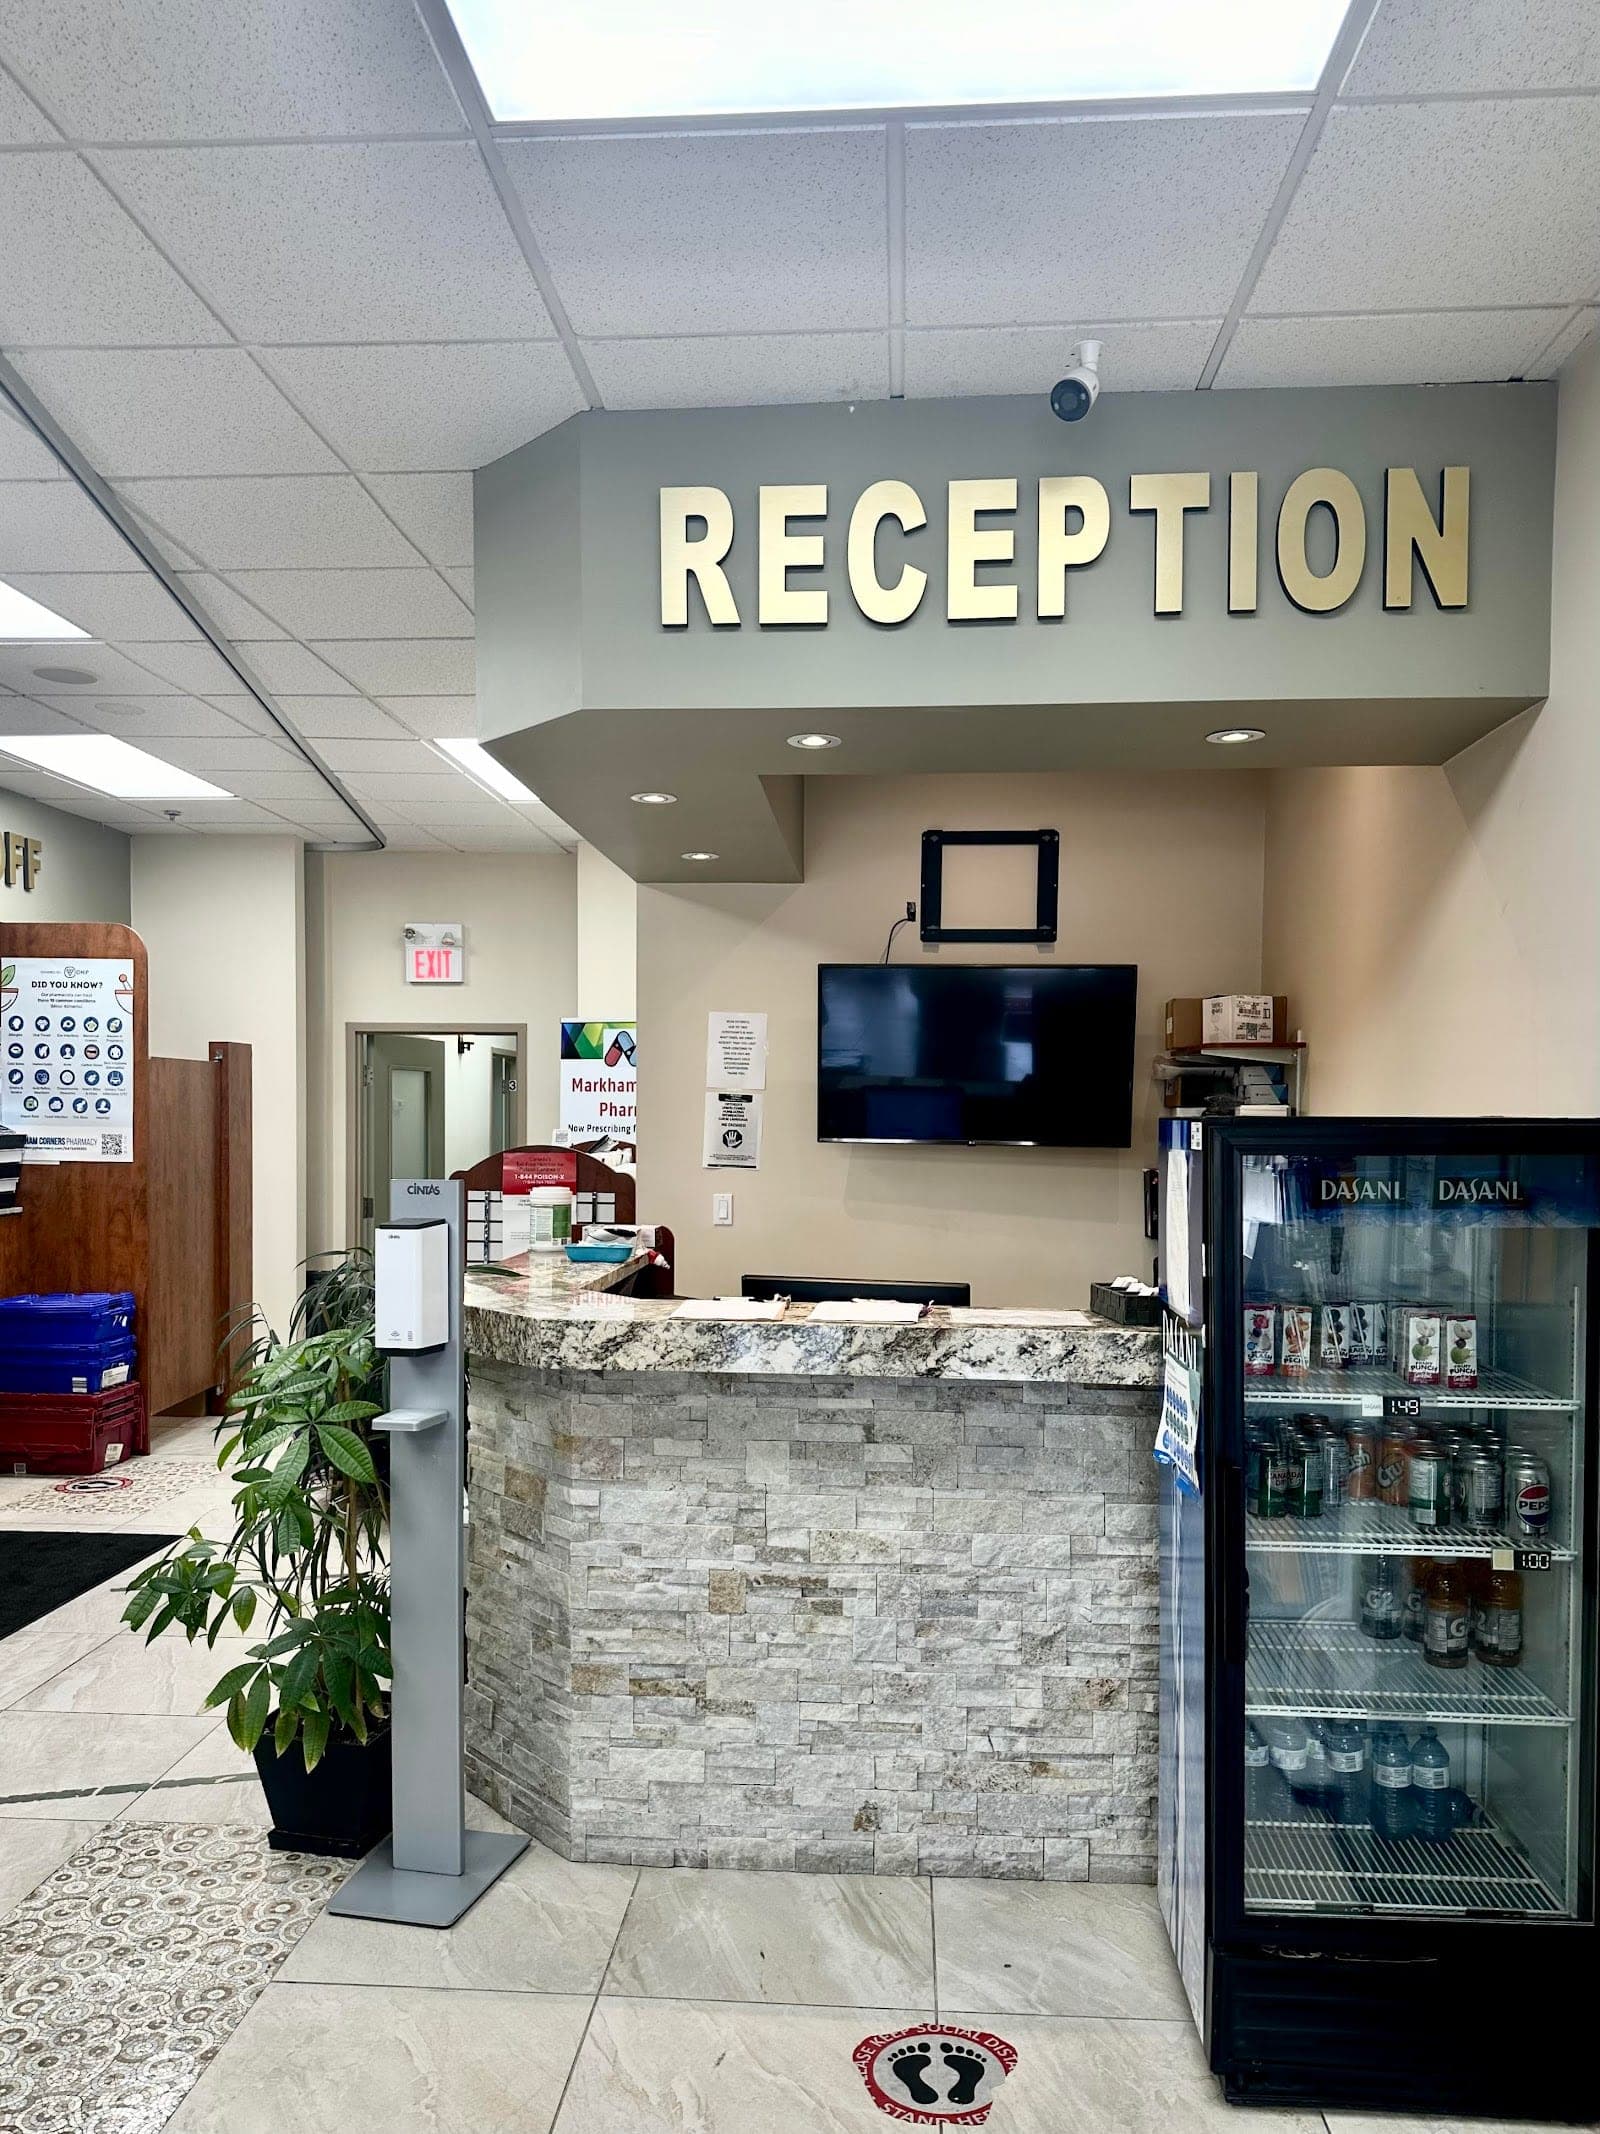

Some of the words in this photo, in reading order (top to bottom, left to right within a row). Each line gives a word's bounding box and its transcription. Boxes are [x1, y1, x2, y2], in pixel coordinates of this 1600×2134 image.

[659, 466, 1470, 628] RECEPTION
[0, 831, 42, 892] FF
[414, 950, 452, 978] EXIT
[70, 981, 103, 989] KNOW?
[509, 1080, 516, 1090] 3
[599, 1101, 637, 1117] Phar
[568, 1124, 585, 1133] Now
[586, 1124, 631, 1135] Prescribing
[39, 1137, 66, 1146] CORNERS
[66, 1138, 97, 1146] PHARMACY
[1321, 1177, 1400, 1203] DASANI
[1439, 1177, 1519, 1203] DASANI
[1410, 1363, 1438, 1372] PUNCH
[1391, 1399, 1419, 1415] 1.49
[1522, 1553, 1550, 1569] 1.00
[1366, 1590, 1394, 1609] G2
[1450, 1617, 1466, 1637] G
[916, 2023, 981, 2041] SOCIAL
